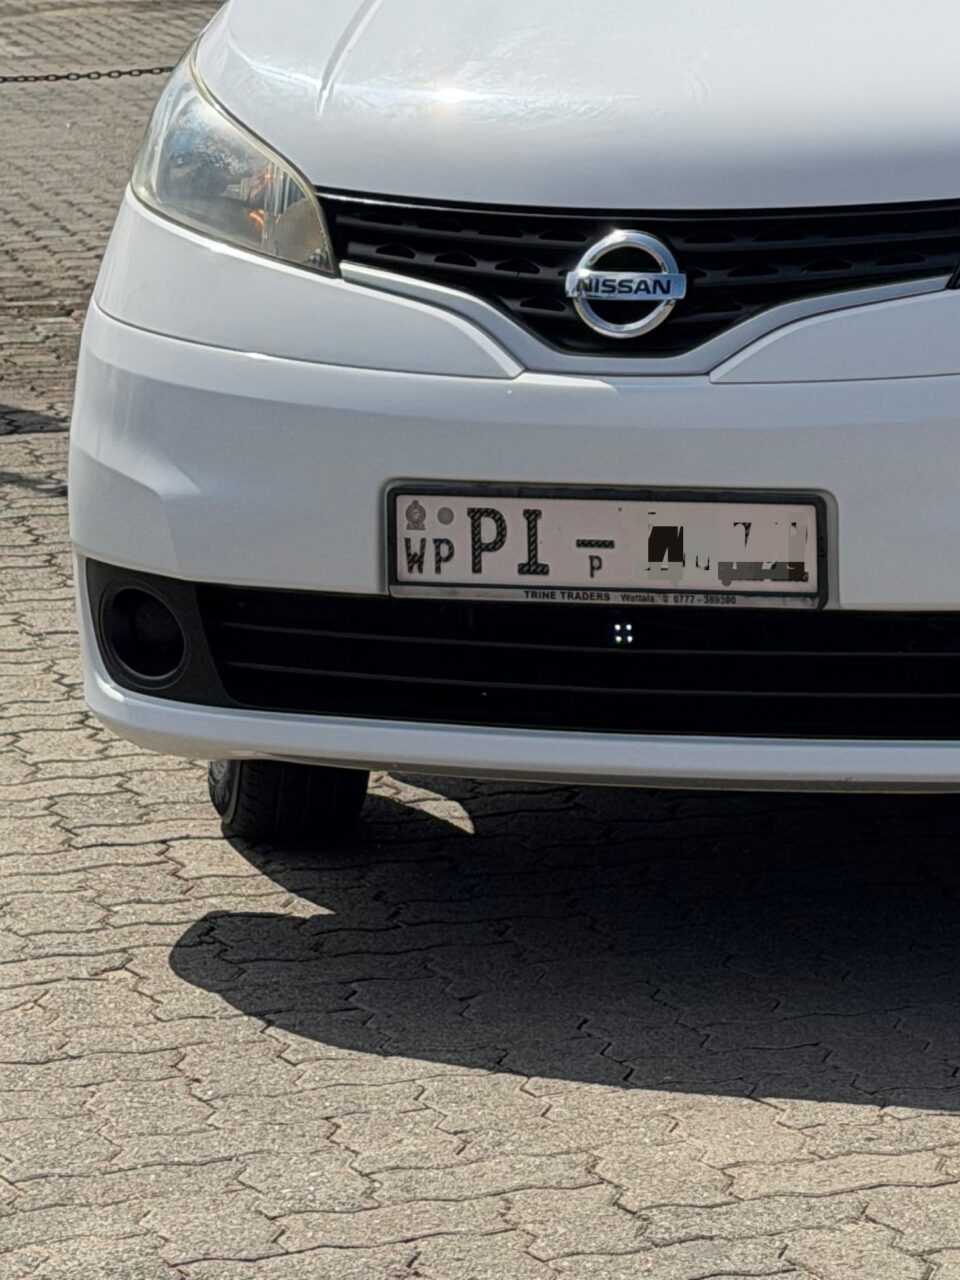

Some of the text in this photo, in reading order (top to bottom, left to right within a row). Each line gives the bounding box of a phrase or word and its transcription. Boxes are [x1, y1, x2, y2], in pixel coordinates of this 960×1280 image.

[576, 277, 672, 295] NISSAN
[404, 537, 455, 574] WP
[467, 506, 550, 576] PI
[523, 589, 557, 600] TRINE
[560, 590, 611, 601] TRADERS
